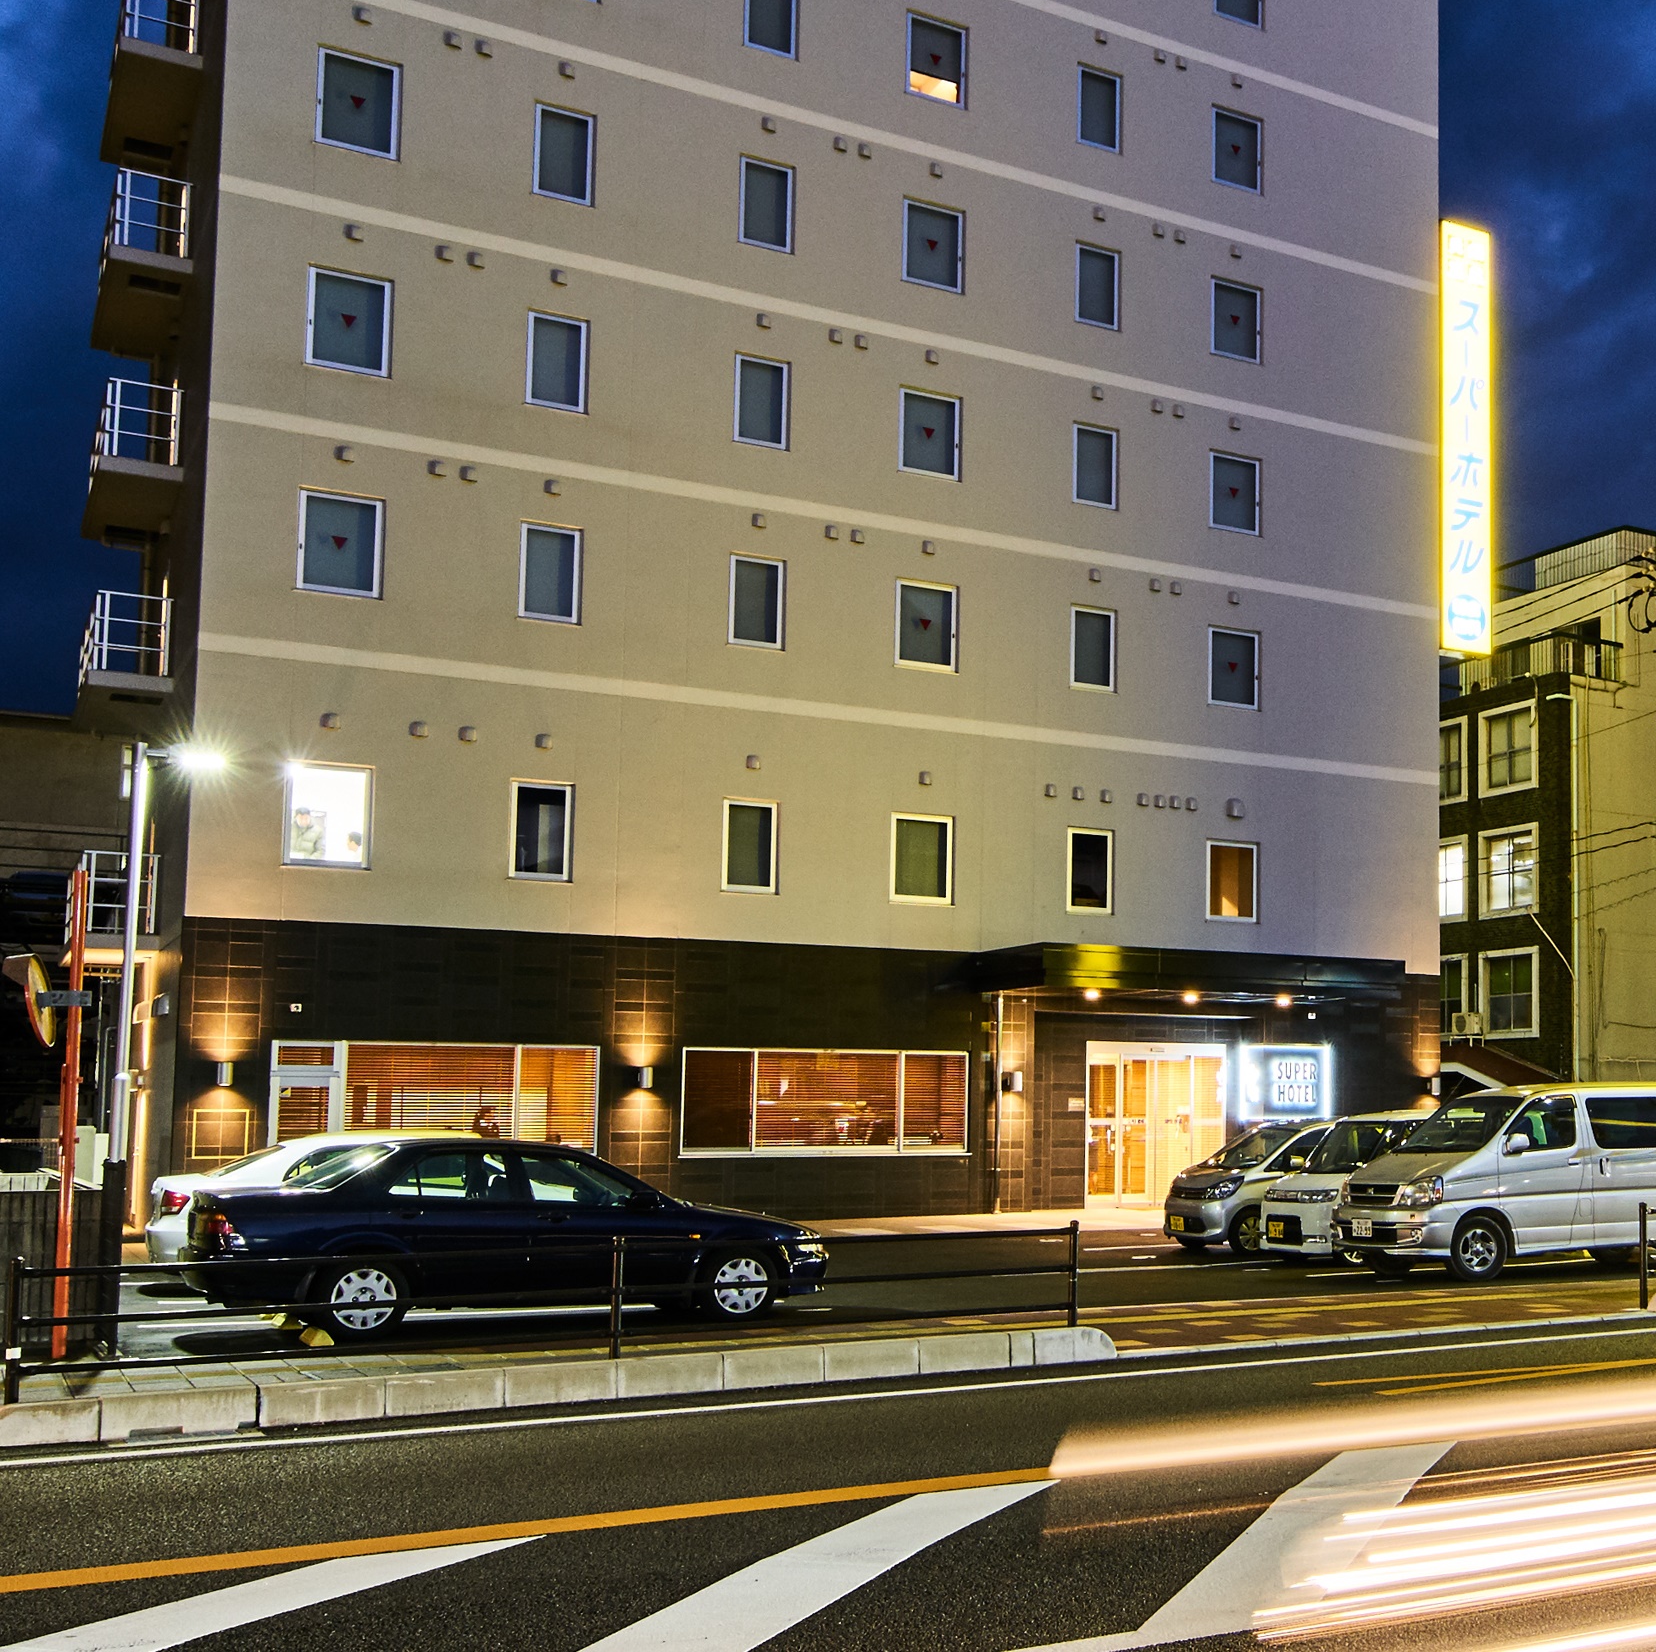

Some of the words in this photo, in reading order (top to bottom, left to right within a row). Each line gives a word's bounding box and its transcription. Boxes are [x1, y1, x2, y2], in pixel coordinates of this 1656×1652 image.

[1449, 300, 1485, 574] スーパーホテル
[1277, 1061, 1318, 1080] SUPER
[1277, 1084, 1317, 1103] HOTEL
